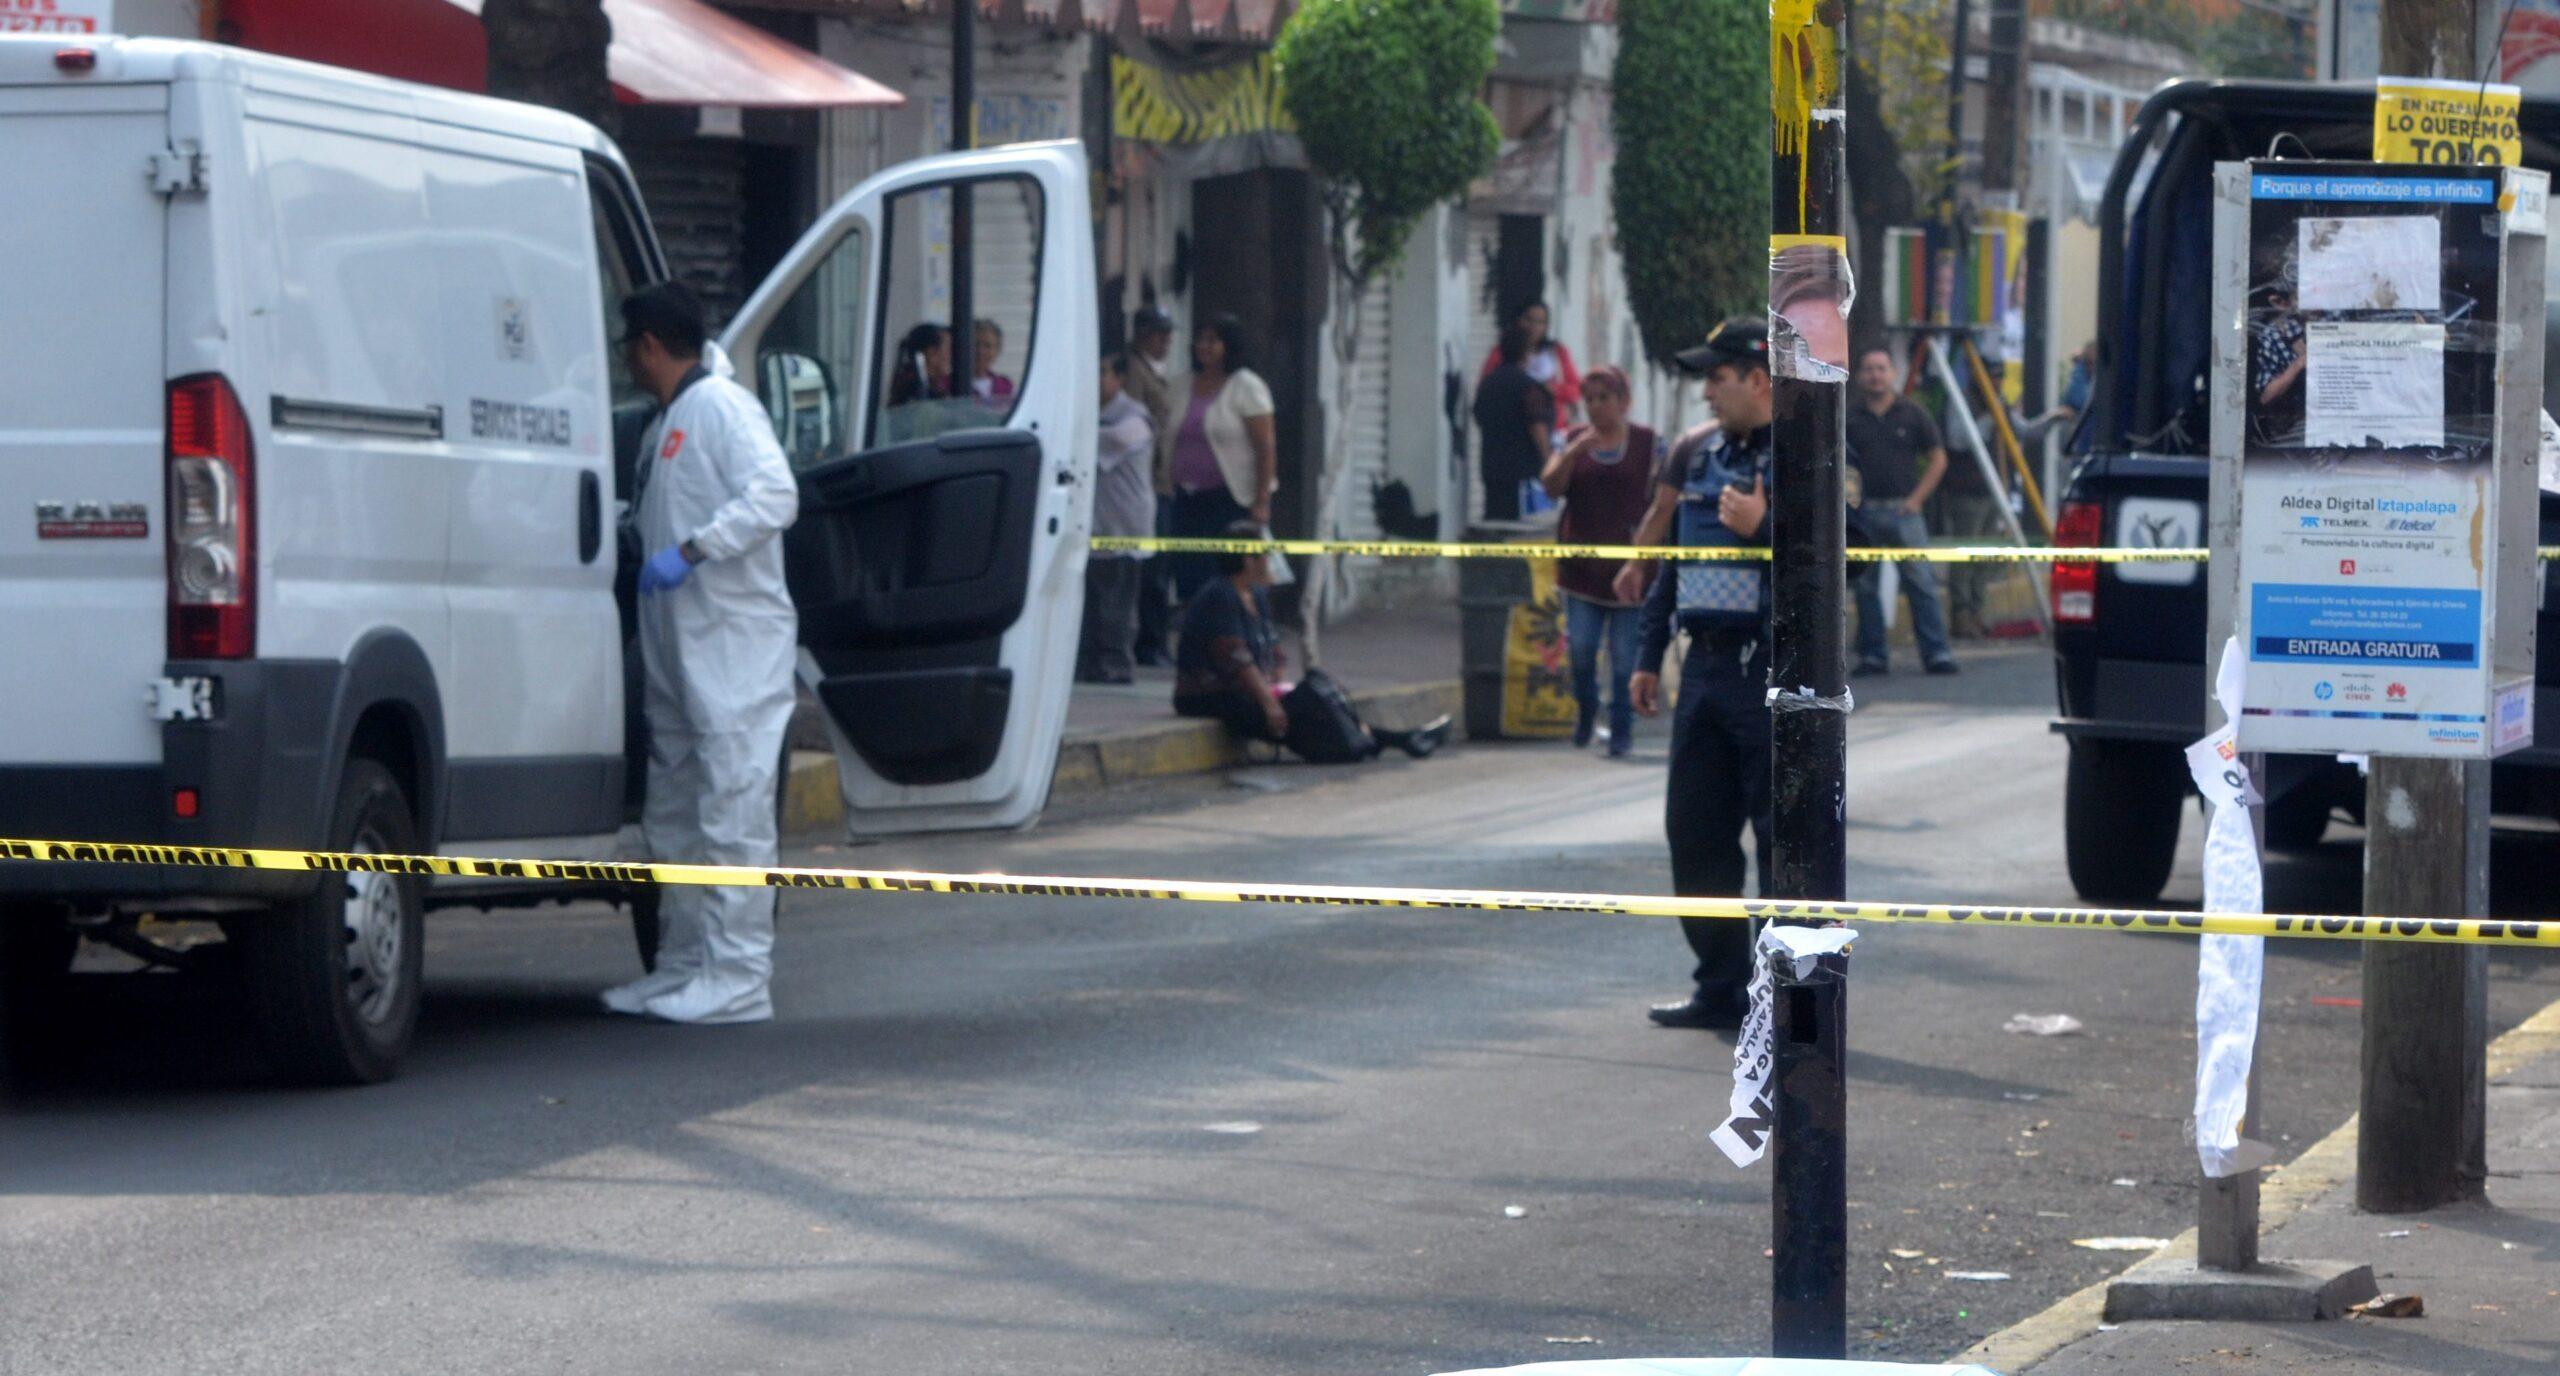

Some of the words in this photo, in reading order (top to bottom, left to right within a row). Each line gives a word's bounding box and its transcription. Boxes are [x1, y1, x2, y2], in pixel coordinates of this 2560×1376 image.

[2401, 99, 2420, 112] EN
[2424, 100, 2517, 120] IZTAPALAPA
[2387, 116, 2414, 132] LO
[2260, 178, 2312, 195] Porque
[2315, 180, 2329, 194] el
[2332, 181, 2411, 199] aprendizaje
[2414, 185, 2431, 197] es
[2434, 182, 2483, 198] infinito
[2281, 496, 2322, 510] Aldea
[2326, 496, 2374, 513] Digital
[2377, 498, 2456, 514] Iztapalapa
[2301, 538, 2359, 548] Promoviendo
[2361, 539, 2370, 548] la
[2371, 540, 2403, 549] cultura
[2405, 540, 2434, 551] digital
[2288, 639, 2361, 656] ENTRADA
[2365, 640, 2440, 659] GRATUITA
[2428, 727, 2480, 738] infinitum
